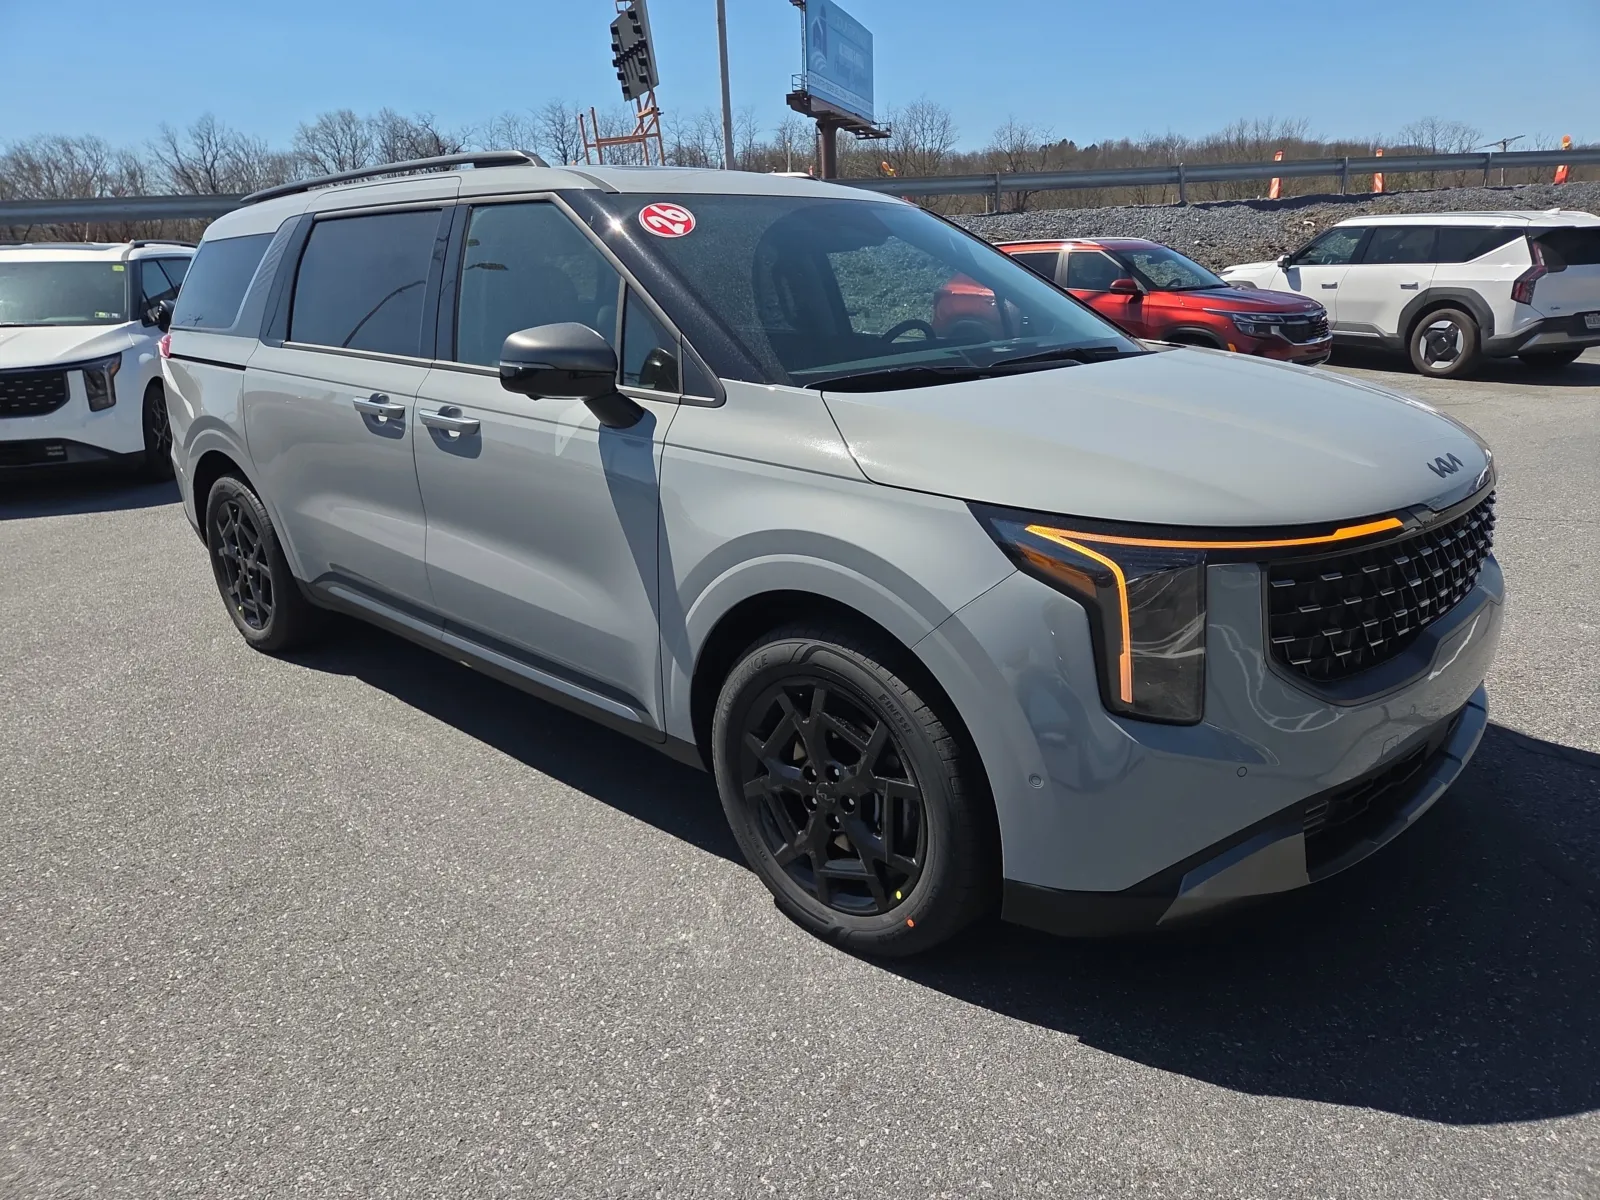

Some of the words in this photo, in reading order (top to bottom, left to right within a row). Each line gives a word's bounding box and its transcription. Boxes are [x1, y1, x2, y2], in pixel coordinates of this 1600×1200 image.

[646, 205, 689, 234] 26
[1426, 452, 1464, 479] KIA
[877, 693, 914, 735] FINESSE
